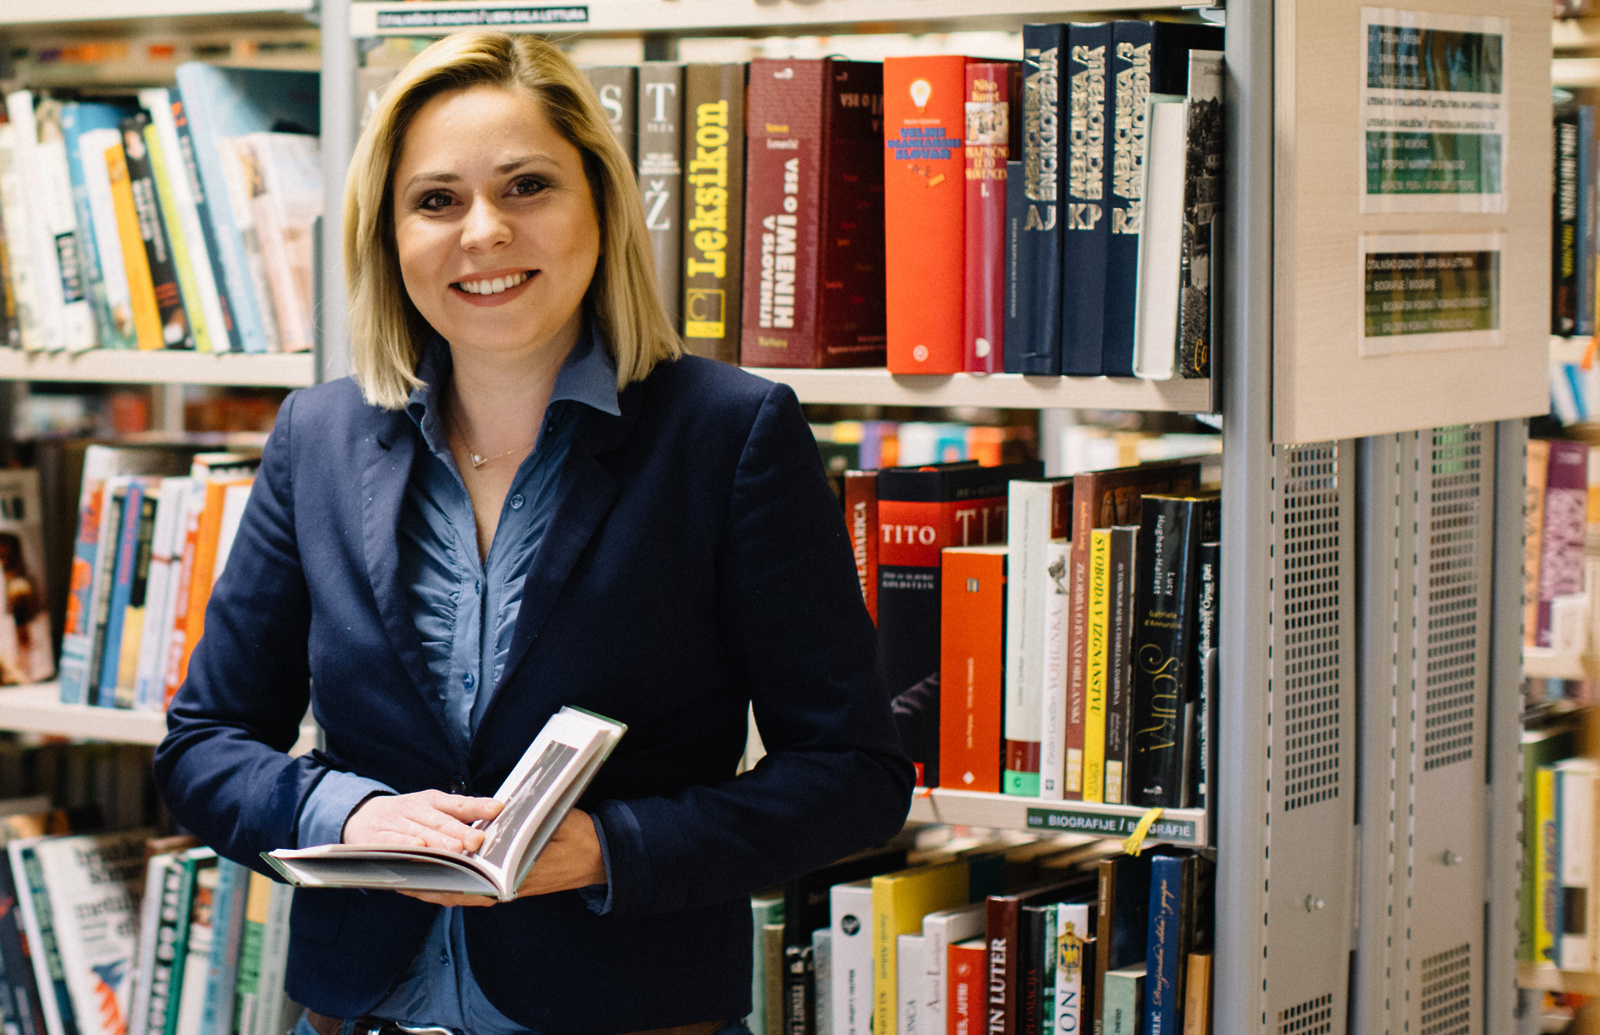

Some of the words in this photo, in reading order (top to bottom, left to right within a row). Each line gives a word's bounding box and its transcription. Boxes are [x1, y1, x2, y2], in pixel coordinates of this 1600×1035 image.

[600, 83, 623, 124] S
[645, 82, 676, 123] T
[839, 93, 860, 108] VSE
[972, 78, 999, 92] Niko
[1024, 71, 1041, 202] MEDICINSKA
[1038, 47, 1058, 202] ENCIKLOPEDIJA
[1069, 70, 1088, 200] MEDICINSKA
[1086, 45, 1106, 200] ENCIKLOPEDIJA
[1112, 67, 1134, 199] MEDICINSKA
[783, 157, 800, 194] VSE
[895, 148, 951, 160] SLOVAR
[644, 178, 671, 231] Ž
[687, 99, 729, 279] Leksikon
[783, 195, 799, 213] O
[762, 215, 775, 230] V
[1023, 204, 1057, 231] AJ
[1067, 203, 1103, 231] KP
[758, 233, 775, 329] SLOVENIJI
[773, 214, 798, 329] IMENIH
[881, 523, 937, 546] TITO
[1152, 514, 1166, 595] Hughes-Hallett
[1074, 561, 1086, 611] ZGODBA
[1093, 535, 1106, 606] SVOBODA
[1164, 571, 1176, 597] Lucy
[1093, 608, 1104, 622] V
[1047, 610, 1062, 691] VOHUNKA
[1089, 622, 1104, 717] IZGNANSTVU
[1048, 814, 1117, 832] BIOGRAFIJE
[1127, 821, 1192, 838] BIGRAFIE
[989, 937, 1007, 1005] LUTER
[988, 1008, 1006, 1035] IN
[1059, 989, 1077, 1033] ON
